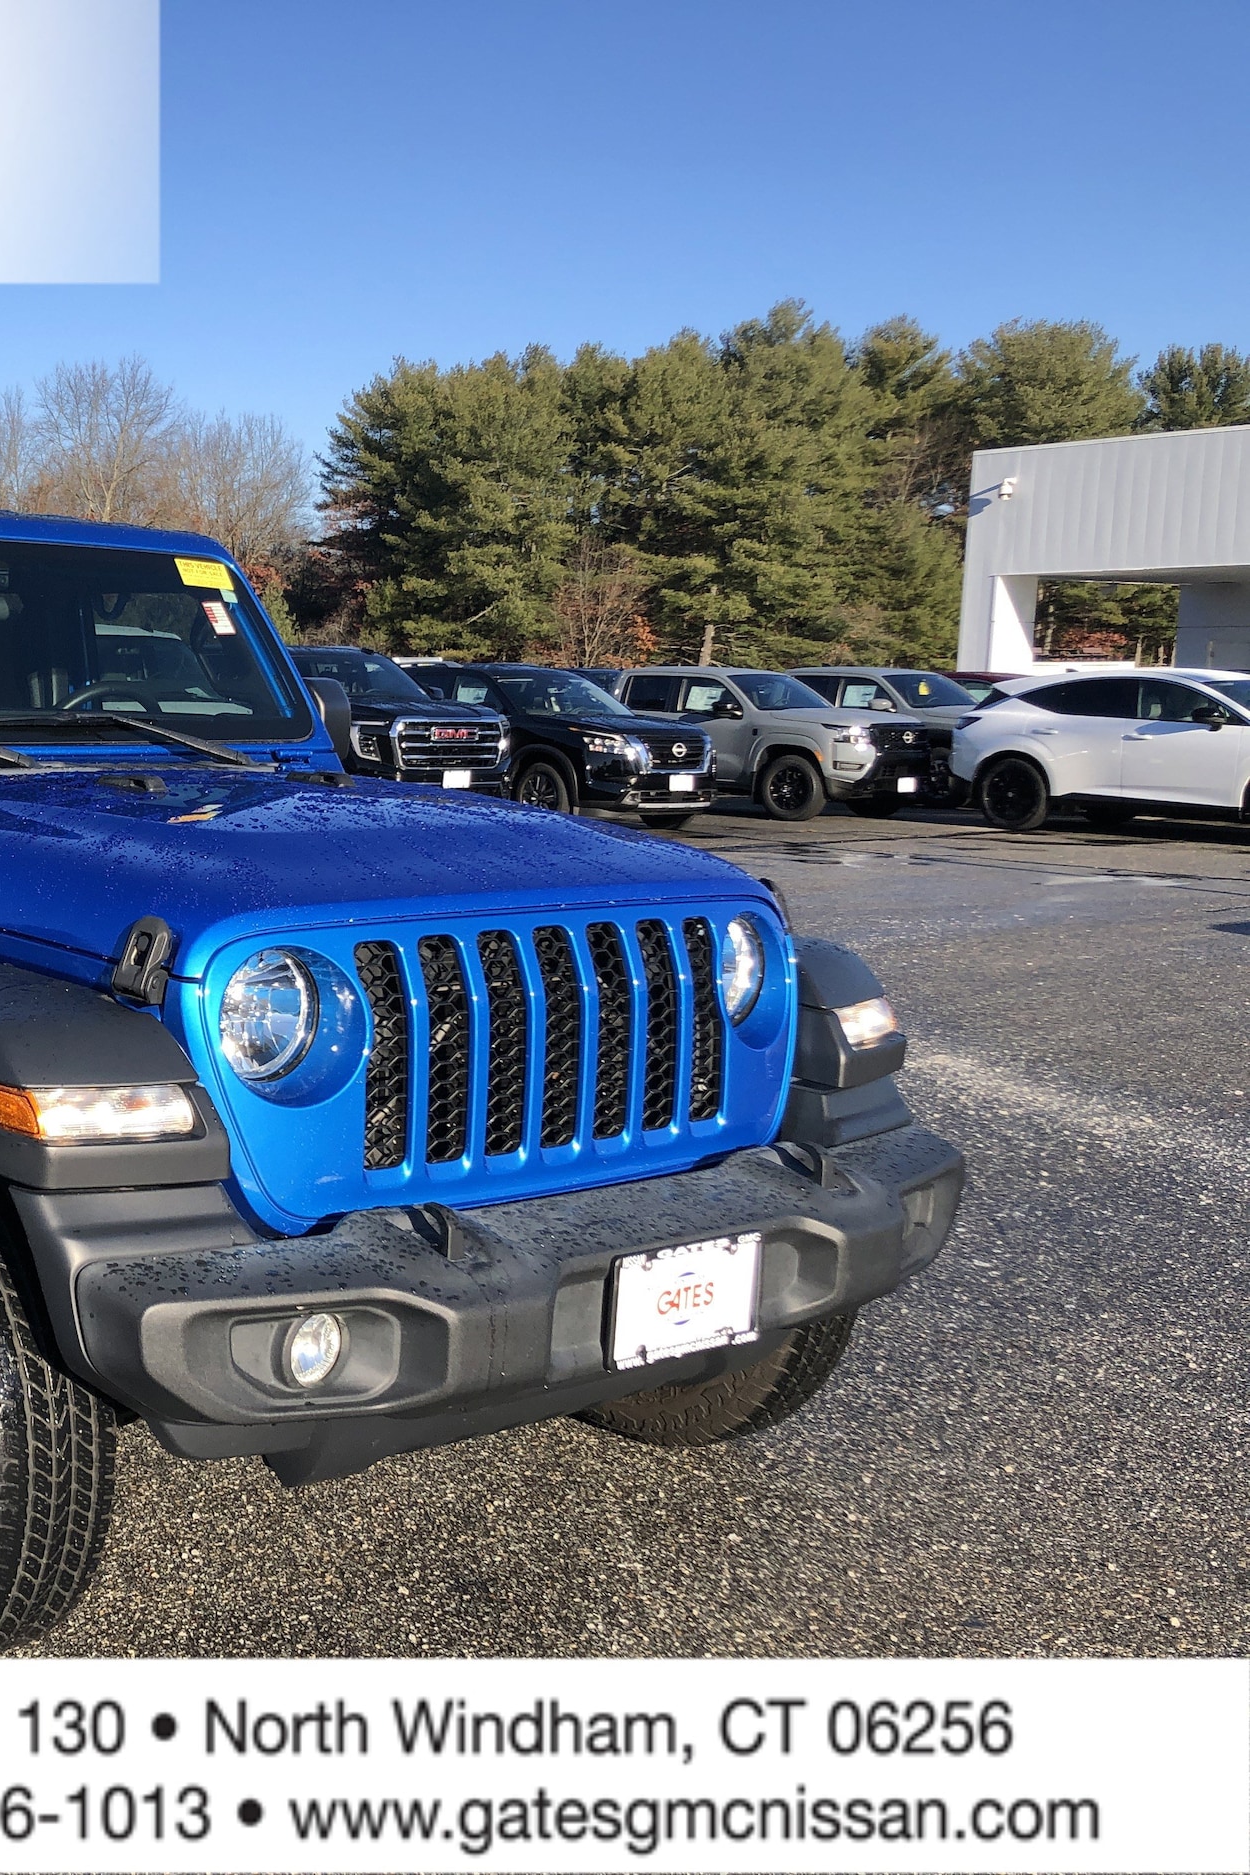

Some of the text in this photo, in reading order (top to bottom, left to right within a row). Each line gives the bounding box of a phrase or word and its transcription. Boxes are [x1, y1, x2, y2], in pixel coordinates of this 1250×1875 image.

[435, 728, 477, 739] GMC
[737, 1232, 762, 1244] GMC
[657, 1282, 714, 1315] GATES
